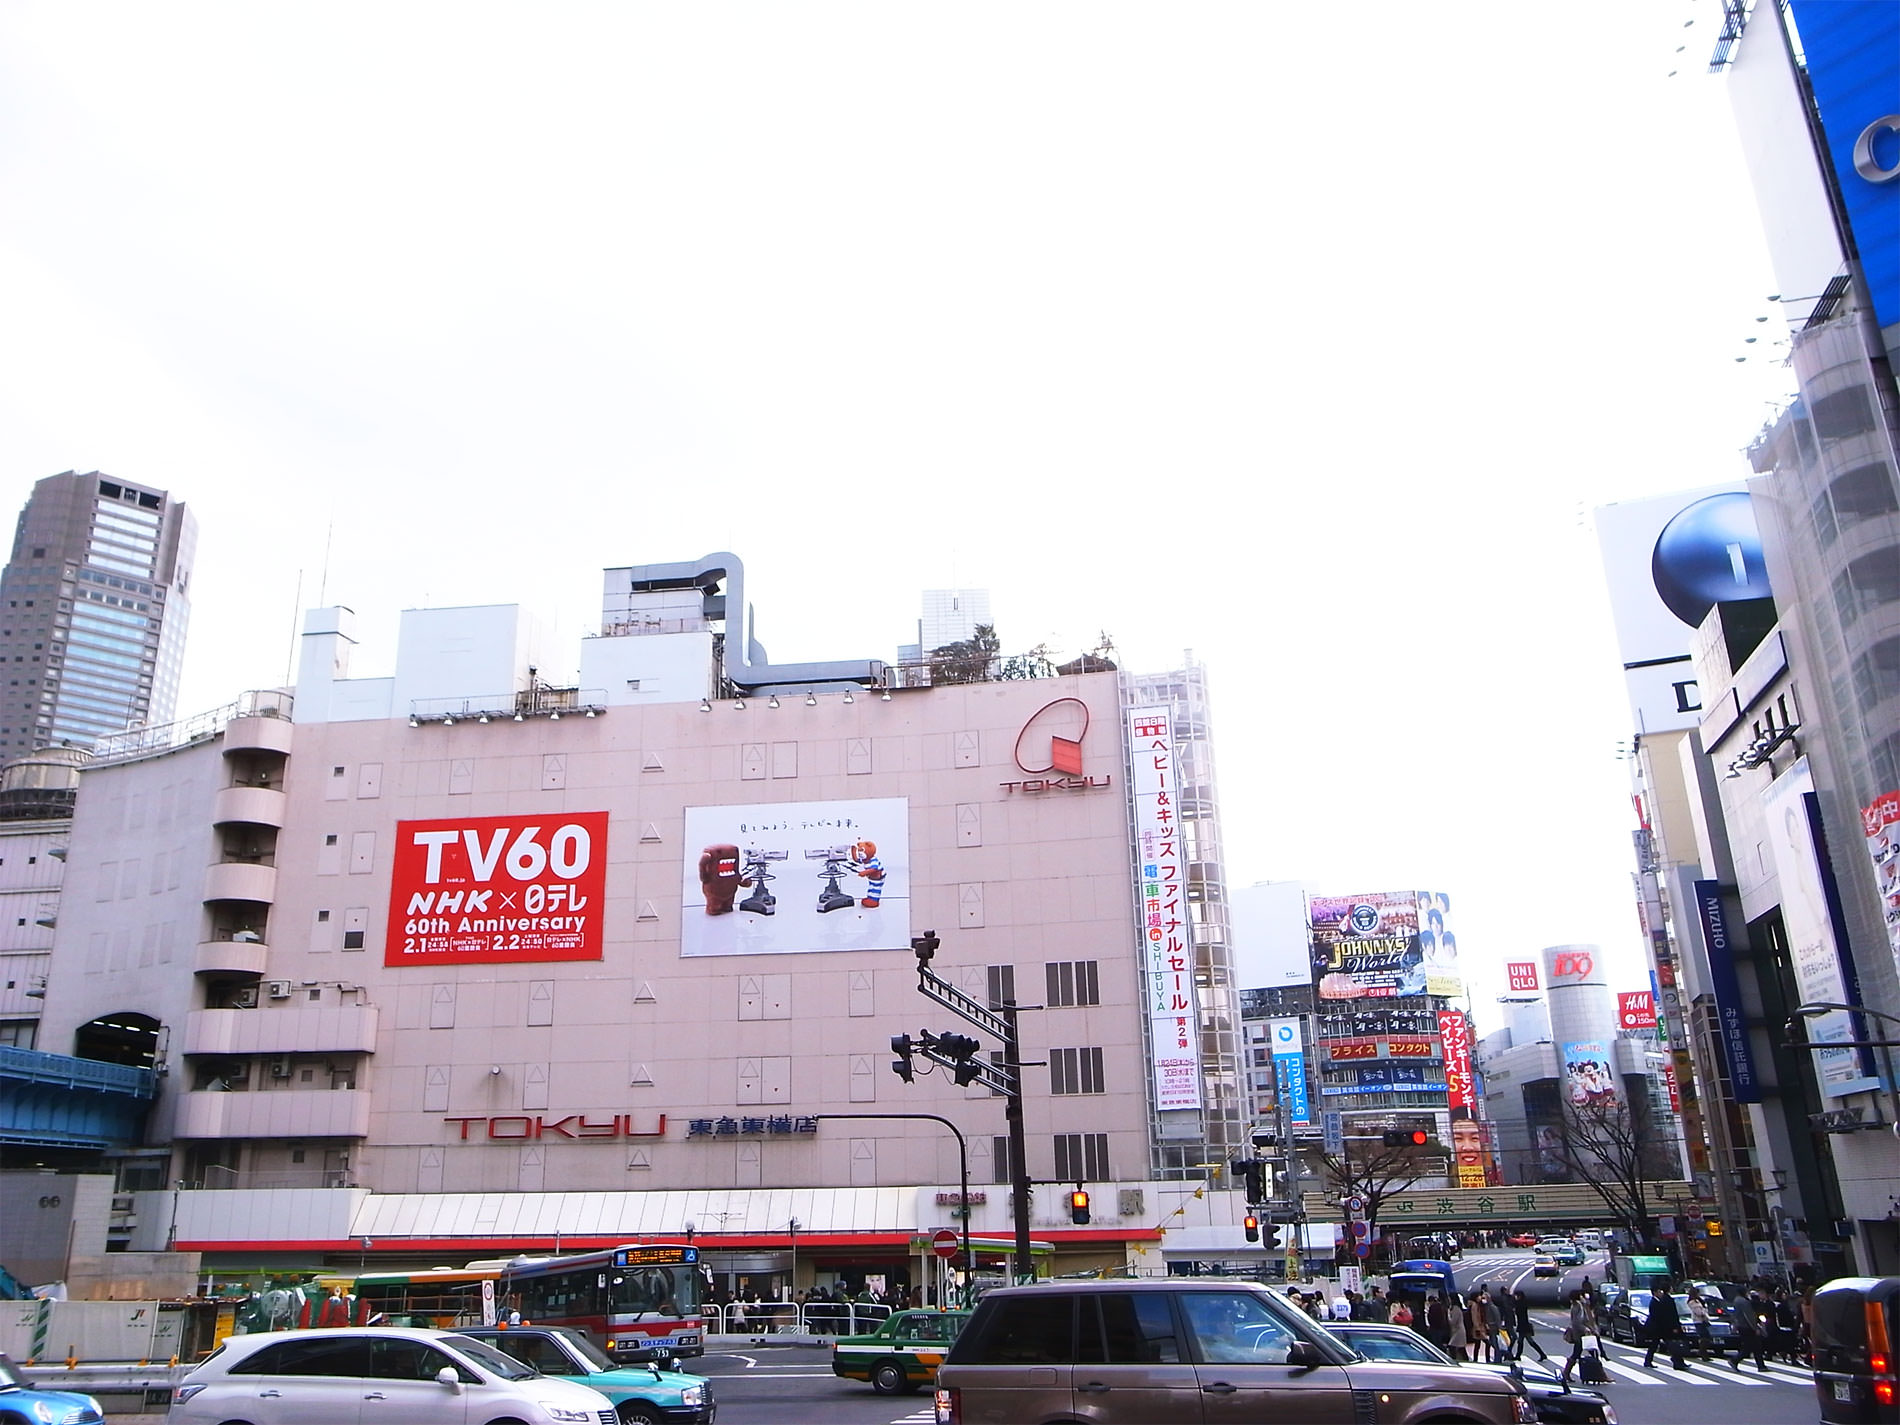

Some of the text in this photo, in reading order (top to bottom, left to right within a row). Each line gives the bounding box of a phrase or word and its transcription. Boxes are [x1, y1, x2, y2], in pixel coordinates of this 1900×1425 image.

[1000, 775, 1110, 794] TOKYU
[413, 824, 591, 884] TV60
[406, 889, 493, 916] NHK
[405, 915, 586, 935] 60th Anniversary
[1706, 897, 1726, 949] MIZUHO
[404, 938, 427, 954] 2.1
[493, 934, 520, 950] 2.2
[1346, 946, 1409, 972] World
[1510, 966, 1532, 976] UNI
[1553, 956, 1593, 981] 109
[1512, 977, 1536, 989] QLO
[1625, 993, 1649, 1011] H&M
[1439, 1016, 1461, 1092] ベイビーズ 5
[1451, 1015, 1474, 1119] ファンキーモンキー
[443, 1113, 666, 1140] TOKYU
